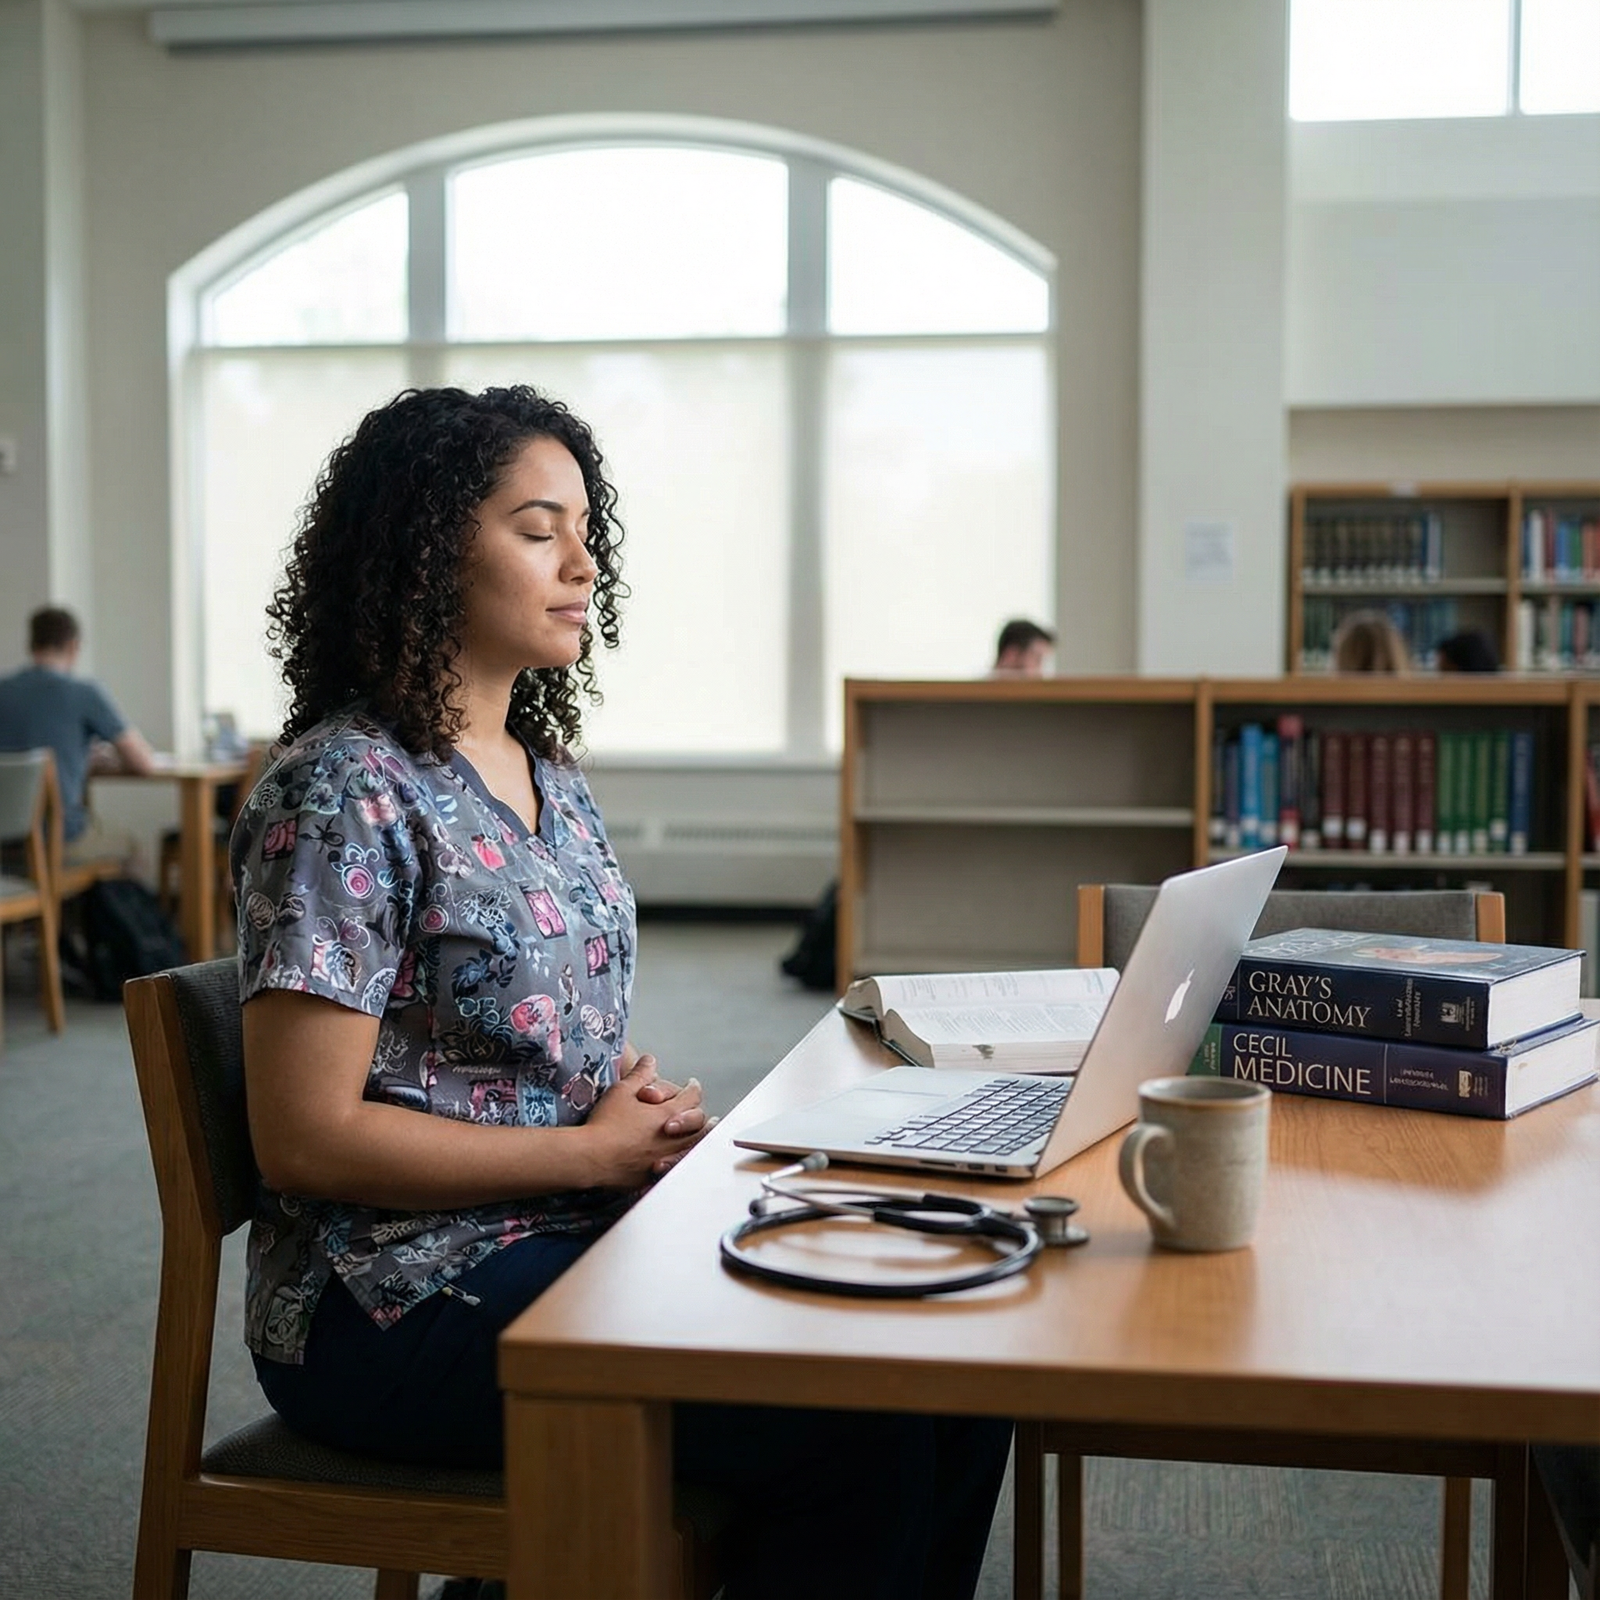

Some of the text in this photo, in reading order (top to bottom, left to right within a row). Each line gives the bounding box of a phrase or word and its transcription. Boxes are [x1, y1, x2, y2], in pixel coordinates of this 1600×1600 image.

[1249, 971, 1332, 999] GRAY'S
[1246, 998, 1372, 1028] ANATOMY
[1233, 1033, 1293, 1057] CECIL
[1233, 1056, 1372, 1095] MEDICINE
